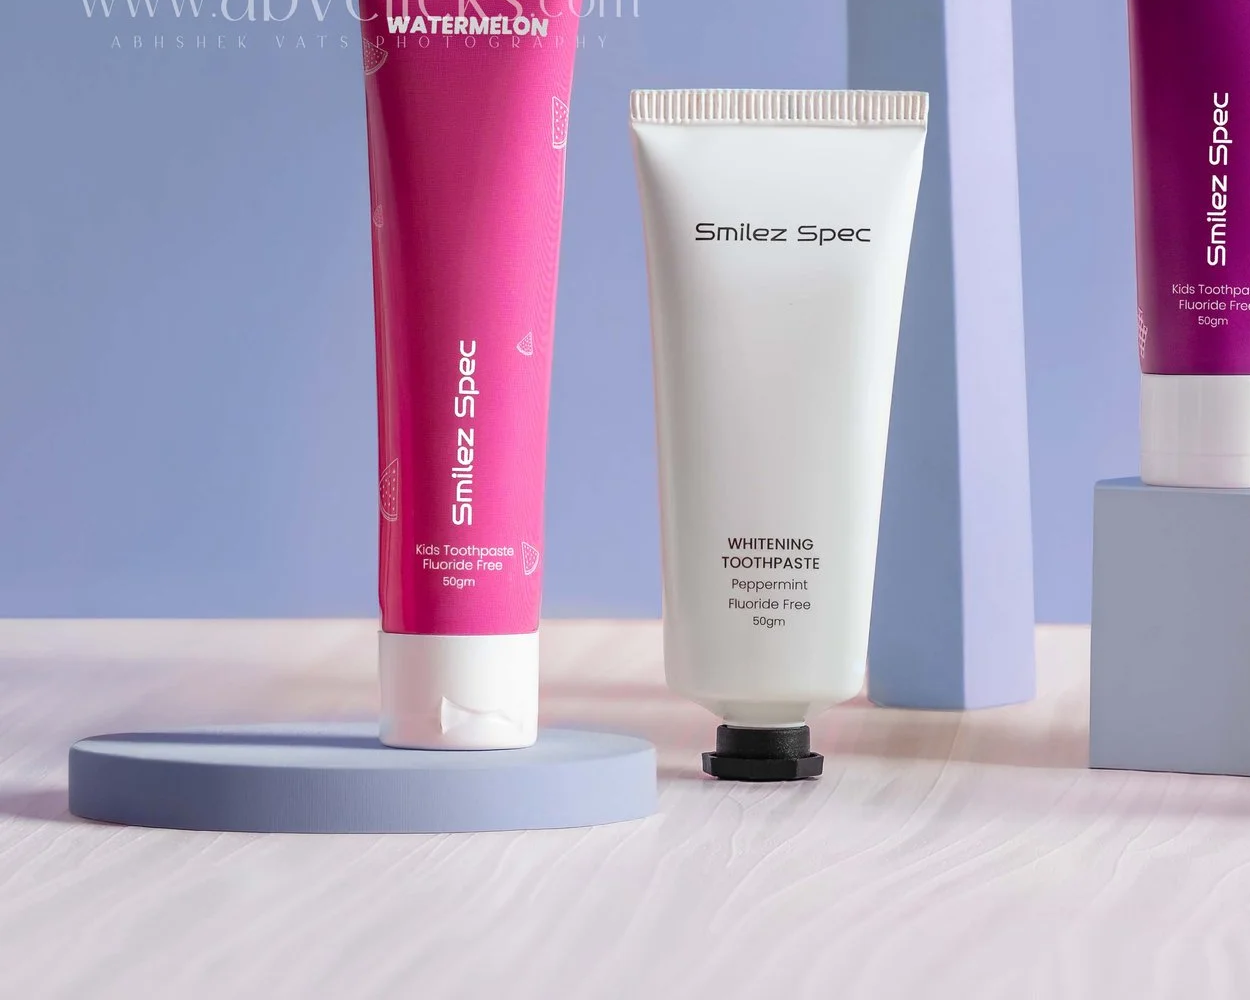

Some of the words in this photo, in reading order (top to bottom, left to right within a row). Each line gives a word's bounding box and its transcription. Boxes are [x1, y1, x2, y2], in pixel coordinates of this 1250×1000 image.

[386, 15, 549, 38] WATERMELON
[1208, 92, 1232, 166] Spec
[1206, 175, 1228, 266] Smilez
[695, 223, 788, 242] Smilez
[797, 225, 871, 246] Spec
[1172, 284, 1196, 294] Kids
[1179, 299, 1227, 310] Fluoride
[1197, 316, 1229, 328] 50gm
[454, 340, 480, 418] Spec
[452, 428, 474, 526] Smilez
[727, 537, 814, 550] WHITENING
[415, 544, 440, 555] Kids
[443, 544, 515, 559] Toothpaste
[423, 559, 473, 570] Fluoride
[476, 560, 503, 571] Free
[721, 556, 820, 570] TOOTHPASTE
[442, 576, 476, 589] 50gm
[731, 578, 808, 592] Peppermint
[728, 598, 779, 609] Fluoride
[783, 599, 811, 610] Free
[752, 616, 786, 628] 50gm
